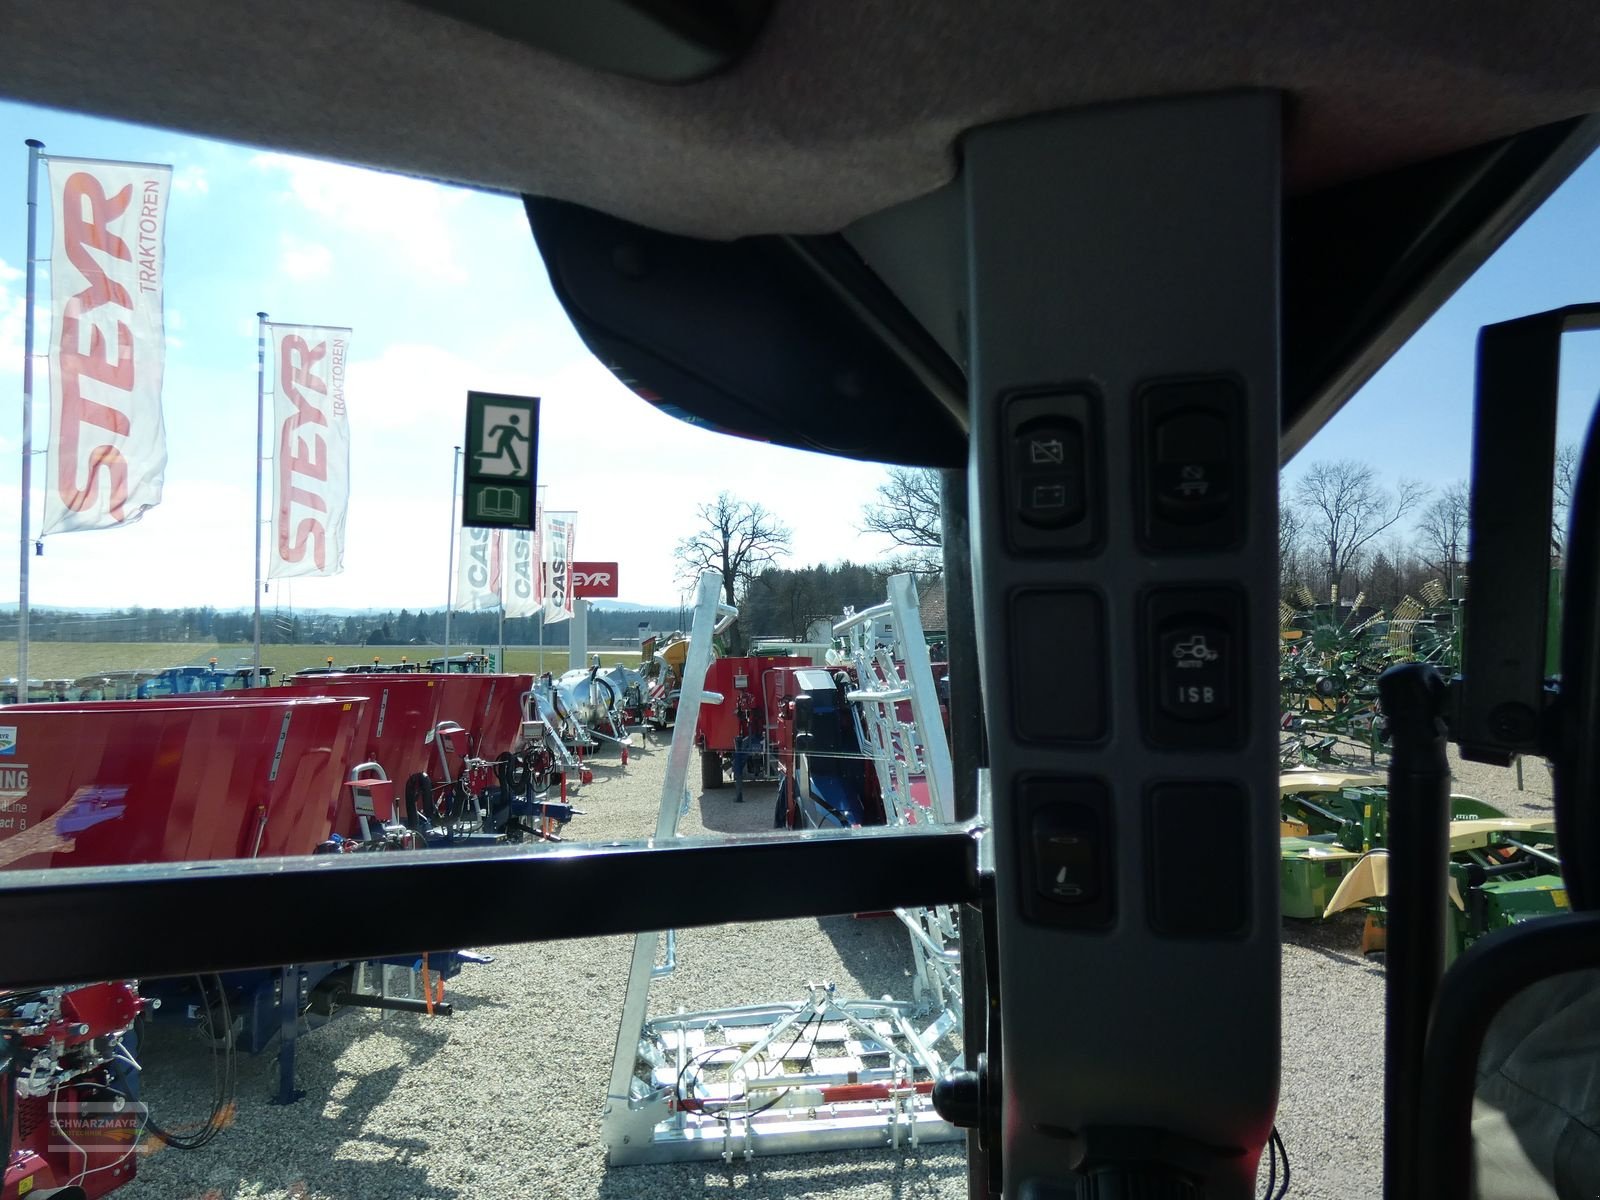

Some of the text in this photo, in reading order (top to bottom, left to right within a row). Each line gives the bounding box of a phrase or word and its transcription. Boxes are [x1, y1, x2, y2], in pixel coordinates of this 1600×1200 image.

[139, 180, 160, 294] TRAKTOREN
[58, 171, 134, 523] STEYR
[333, 338, 345, 417] TRAKTOREN
[279, 334, 327, 572] STEYR
[467, 528, 490, 589] CAS
[551, 541, 566, 608] CASE
[572, 572, 611, 587] EYR
[1178, 686, 1215, 703] ISB
[275, 751, 281, 760] 2
[0, 770, 29, 789] ING
[0, 799, 28, 813] dLine
[0, 817, 27, 831] act 8
